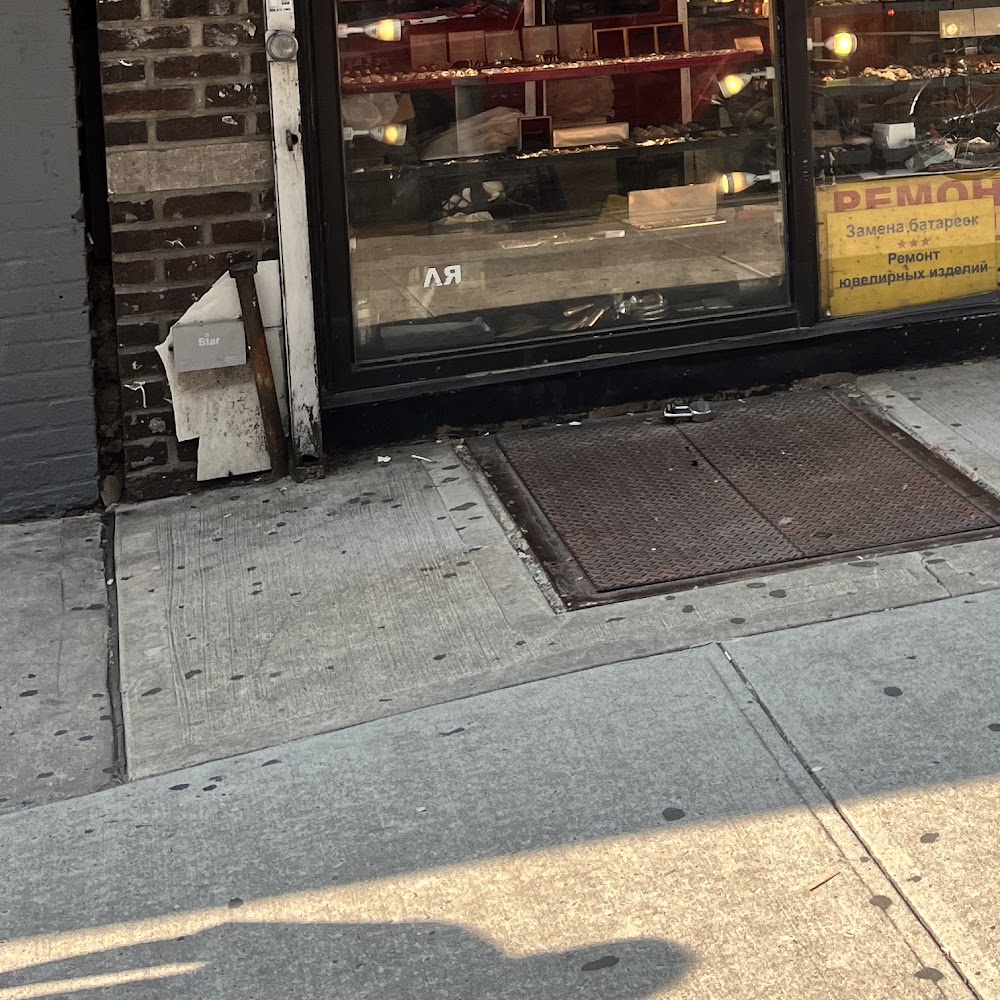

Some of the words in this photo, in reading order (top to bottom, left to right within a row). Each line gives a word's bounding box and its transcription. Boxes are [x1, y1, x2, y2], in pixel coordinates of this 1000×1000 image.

[846, 221, 905, 238] Замена
[909, 215, 980, 233] батареек
[888, 250, 941, 266] Ремонт
[838, 269, 926, 289] ювелирных
[929, 260, 989, 278] изделий
[199, 336, 221, 347] Star
